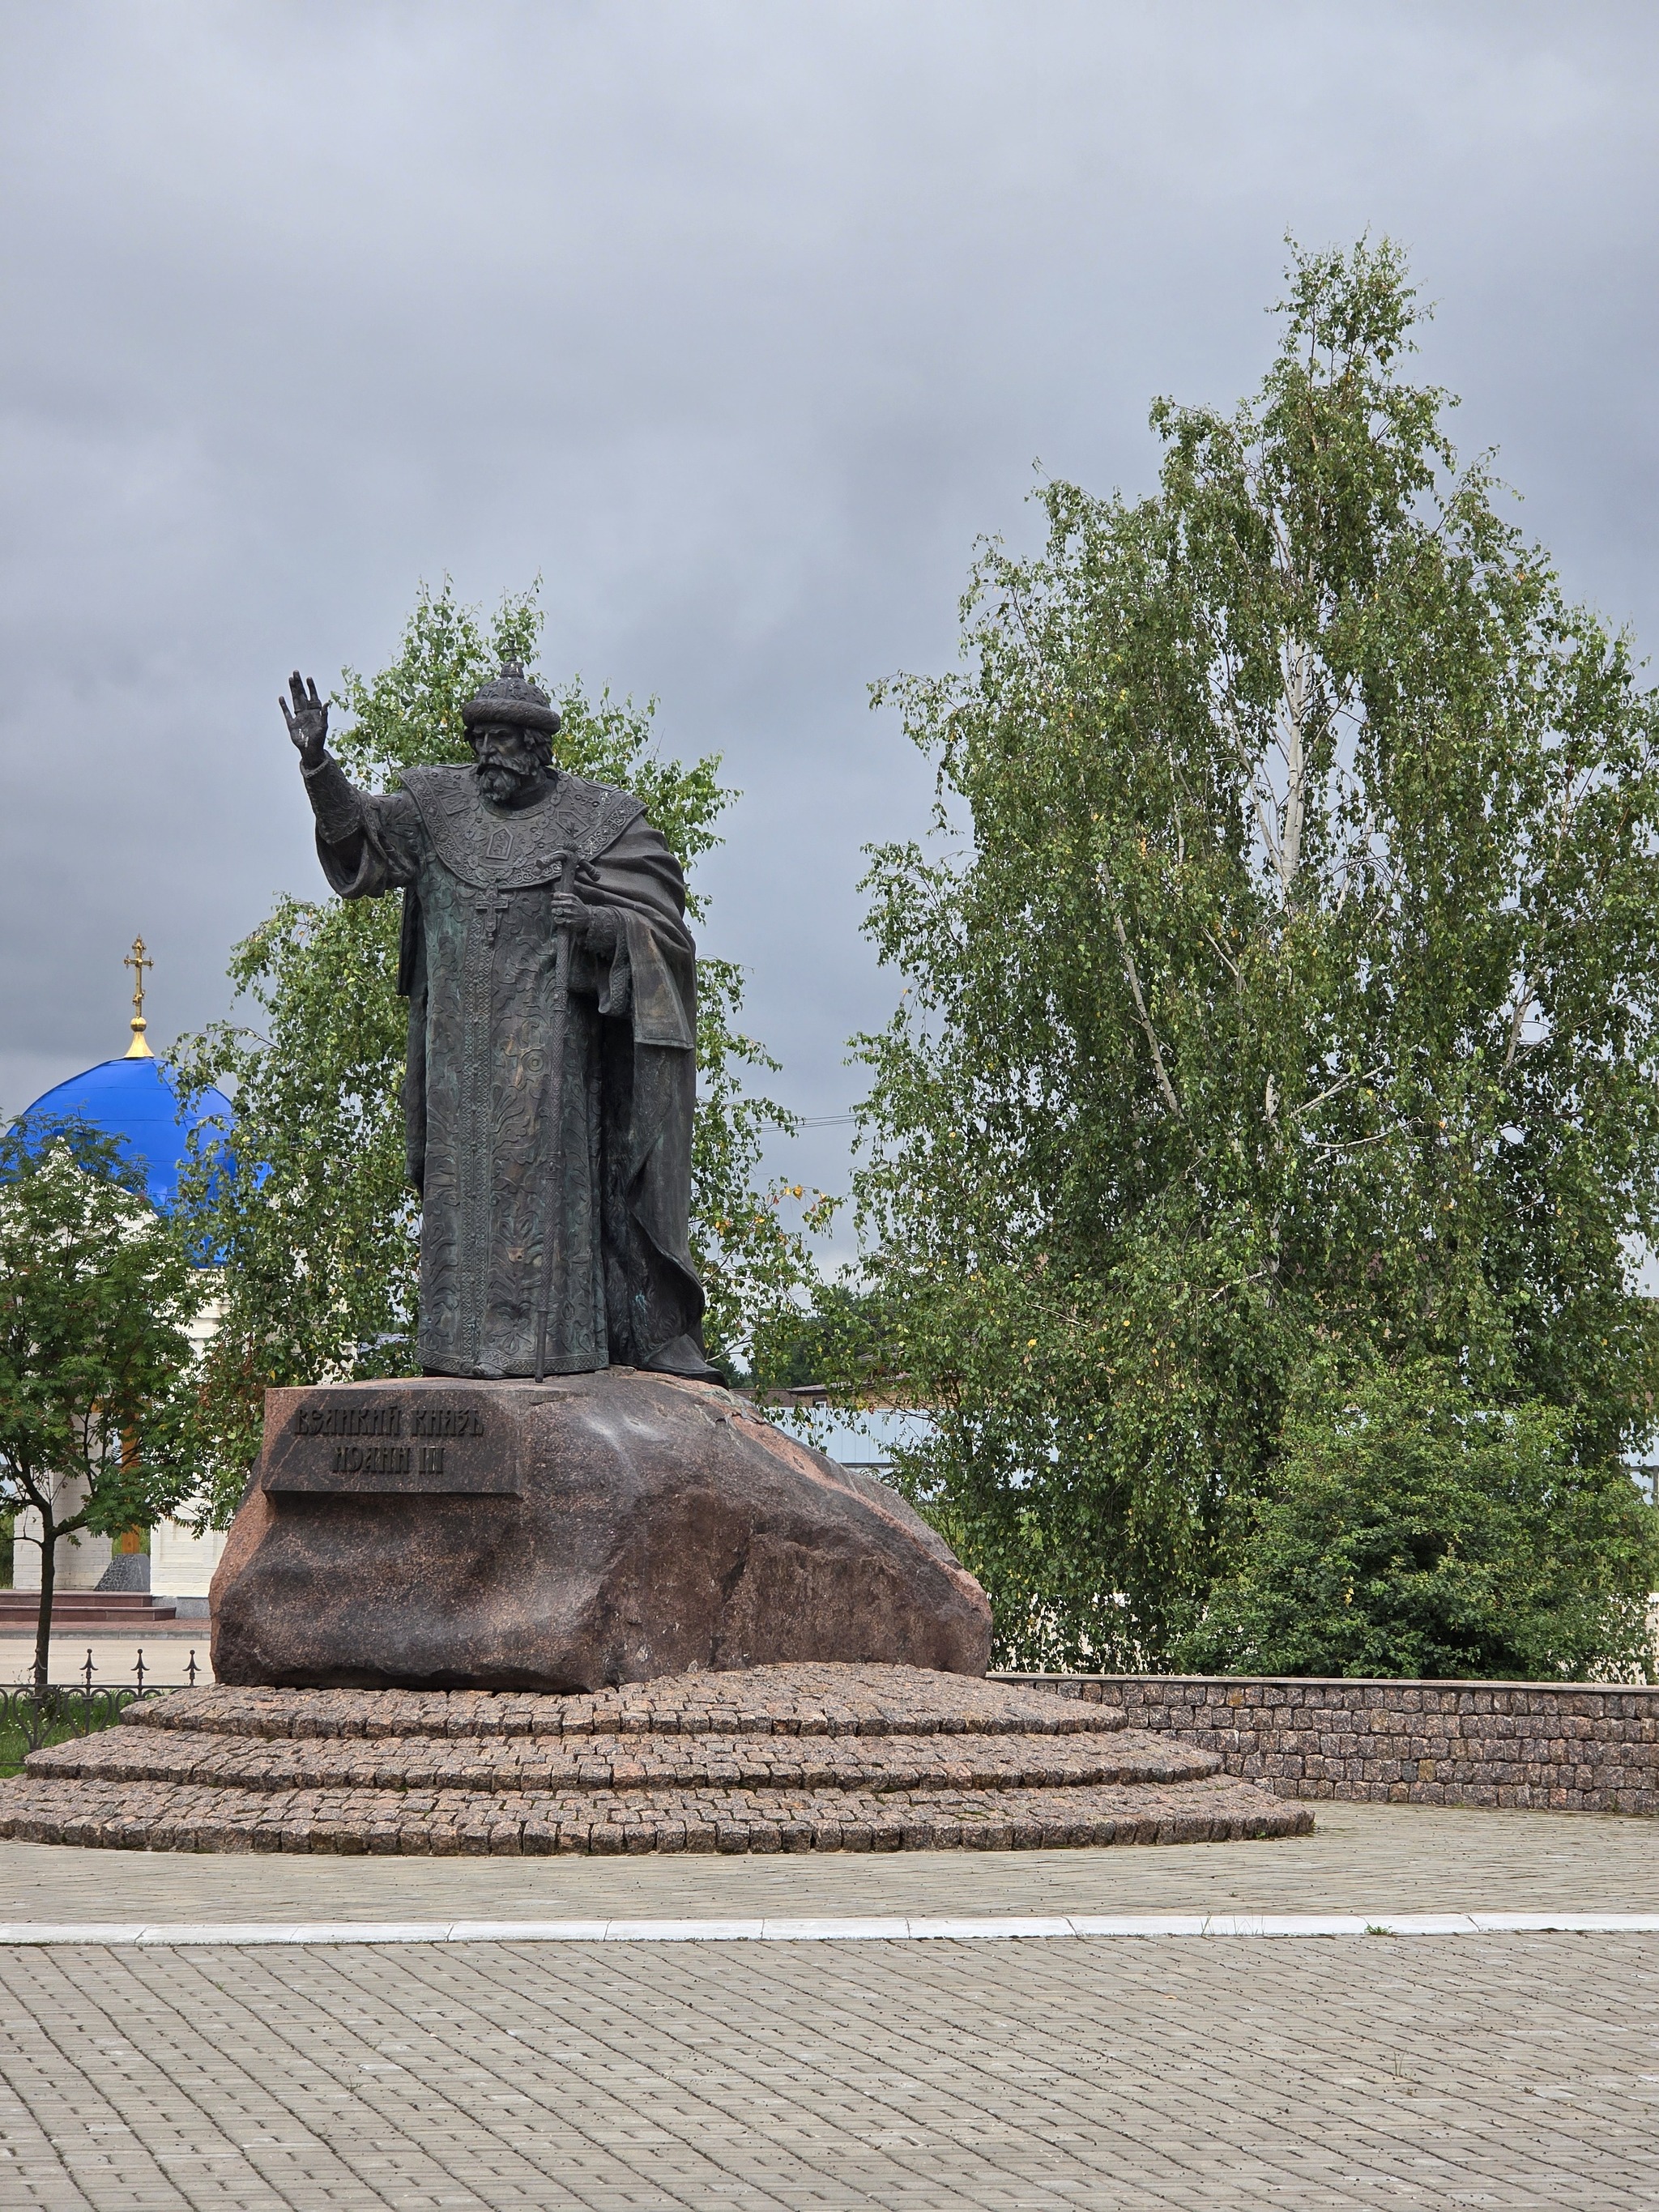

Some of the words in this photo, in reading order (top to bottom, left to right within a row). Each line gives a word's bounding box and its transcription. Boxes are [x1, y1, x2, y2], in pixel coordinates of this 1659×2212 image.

[295, 1406, 402, 1436] ВЕЛИКИЙ
[412, 1409, 485, 1438] КНЯЗЬ
[332, 1446, 411, 1473] ИОАНН
[419, 1447, 446, 1474] III
